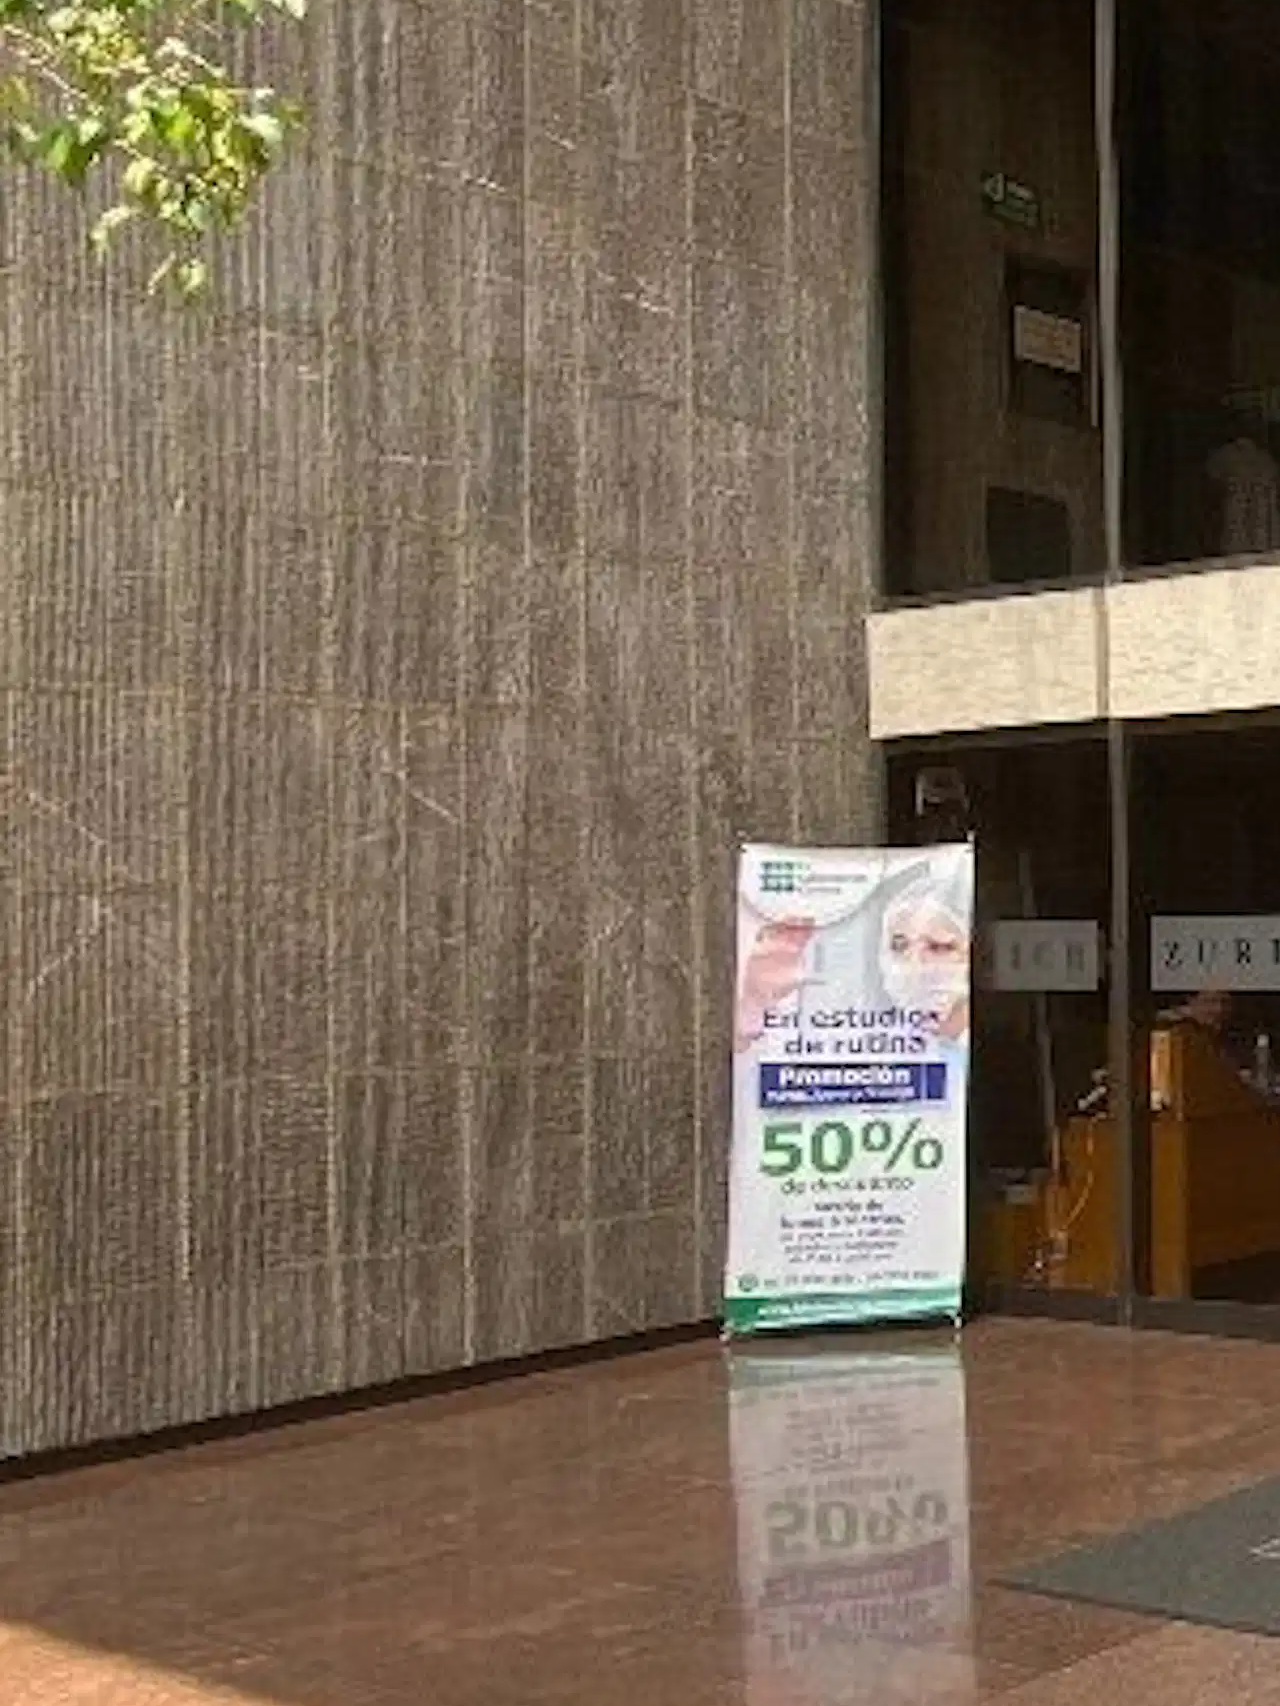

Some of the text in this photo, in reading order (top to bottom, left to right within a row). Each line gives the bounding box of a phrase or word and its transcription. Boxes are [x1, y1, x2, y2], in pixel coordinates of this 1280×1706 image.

[763, 1007, 799, 1028] En
[835, 1032, 927, 1054] rutina
[760, 1117, 945, 1177] 50%
